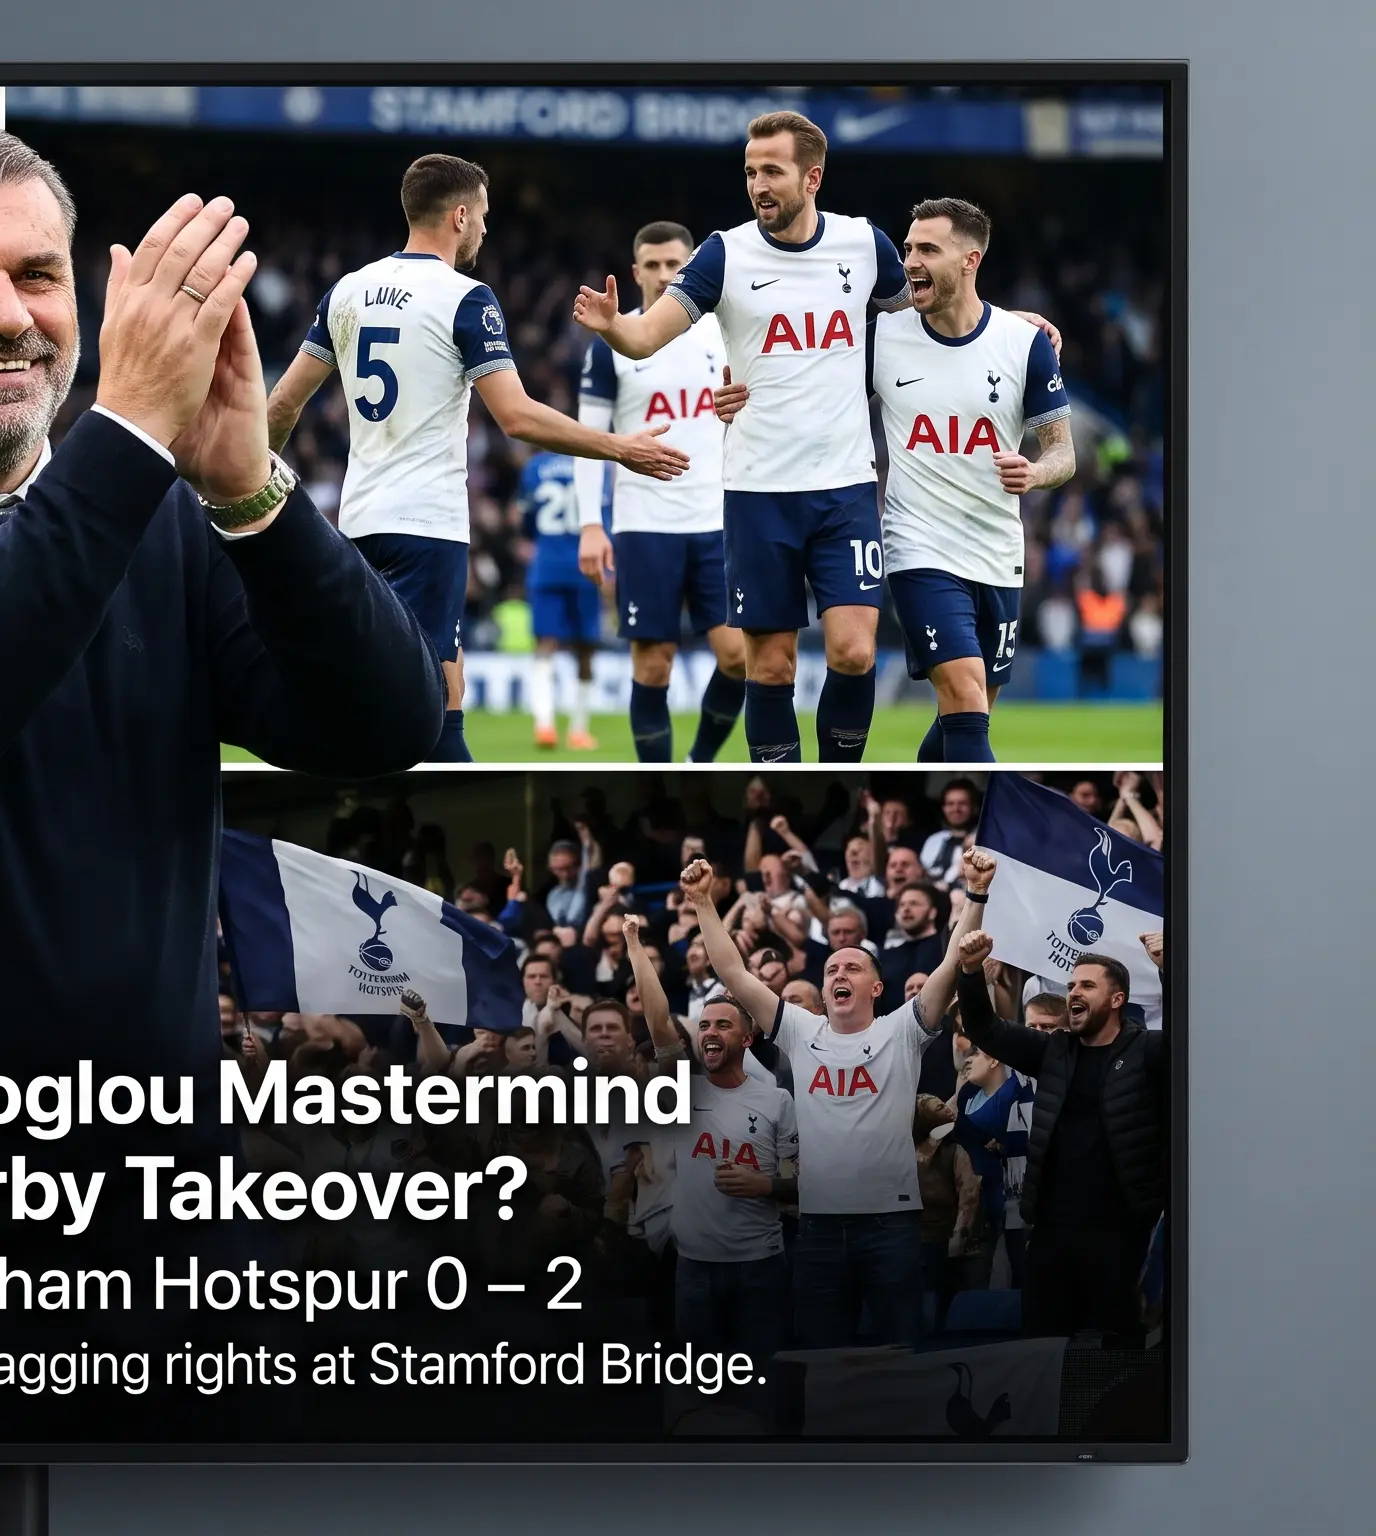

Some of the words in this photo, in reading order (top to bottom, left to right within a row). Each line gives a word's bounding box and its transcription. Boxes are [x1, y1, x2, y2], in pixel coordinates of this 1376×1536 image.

[761, 310, 854, 353] AIA
[354, 326, 400, 422] 5
[645, 387, 717, 422] AIA
[906, 414, 1000, 455] AIA
[850, 539, 883, 579] 10
[996, 619, 1018, 659] 15
[221, 1056, 691, 1125] Mastermind
[808, 1065, 879, 1096] AIA
[691, 1132, 761, 1171] AIA
[125, 1155, 528, 1221] Takeover?
[155, 1256, 408, 1322] Hotspur
[427, 1255, 467, 1310] 0
[547, 1256, 582, 1309] 2
[166, 1341, 297, 1395] rights
[312, 1346, 355, 1385] at
[370, 1341, 584, 1385] Stamford
[602, 1341, 766, 1395] Bridge.
